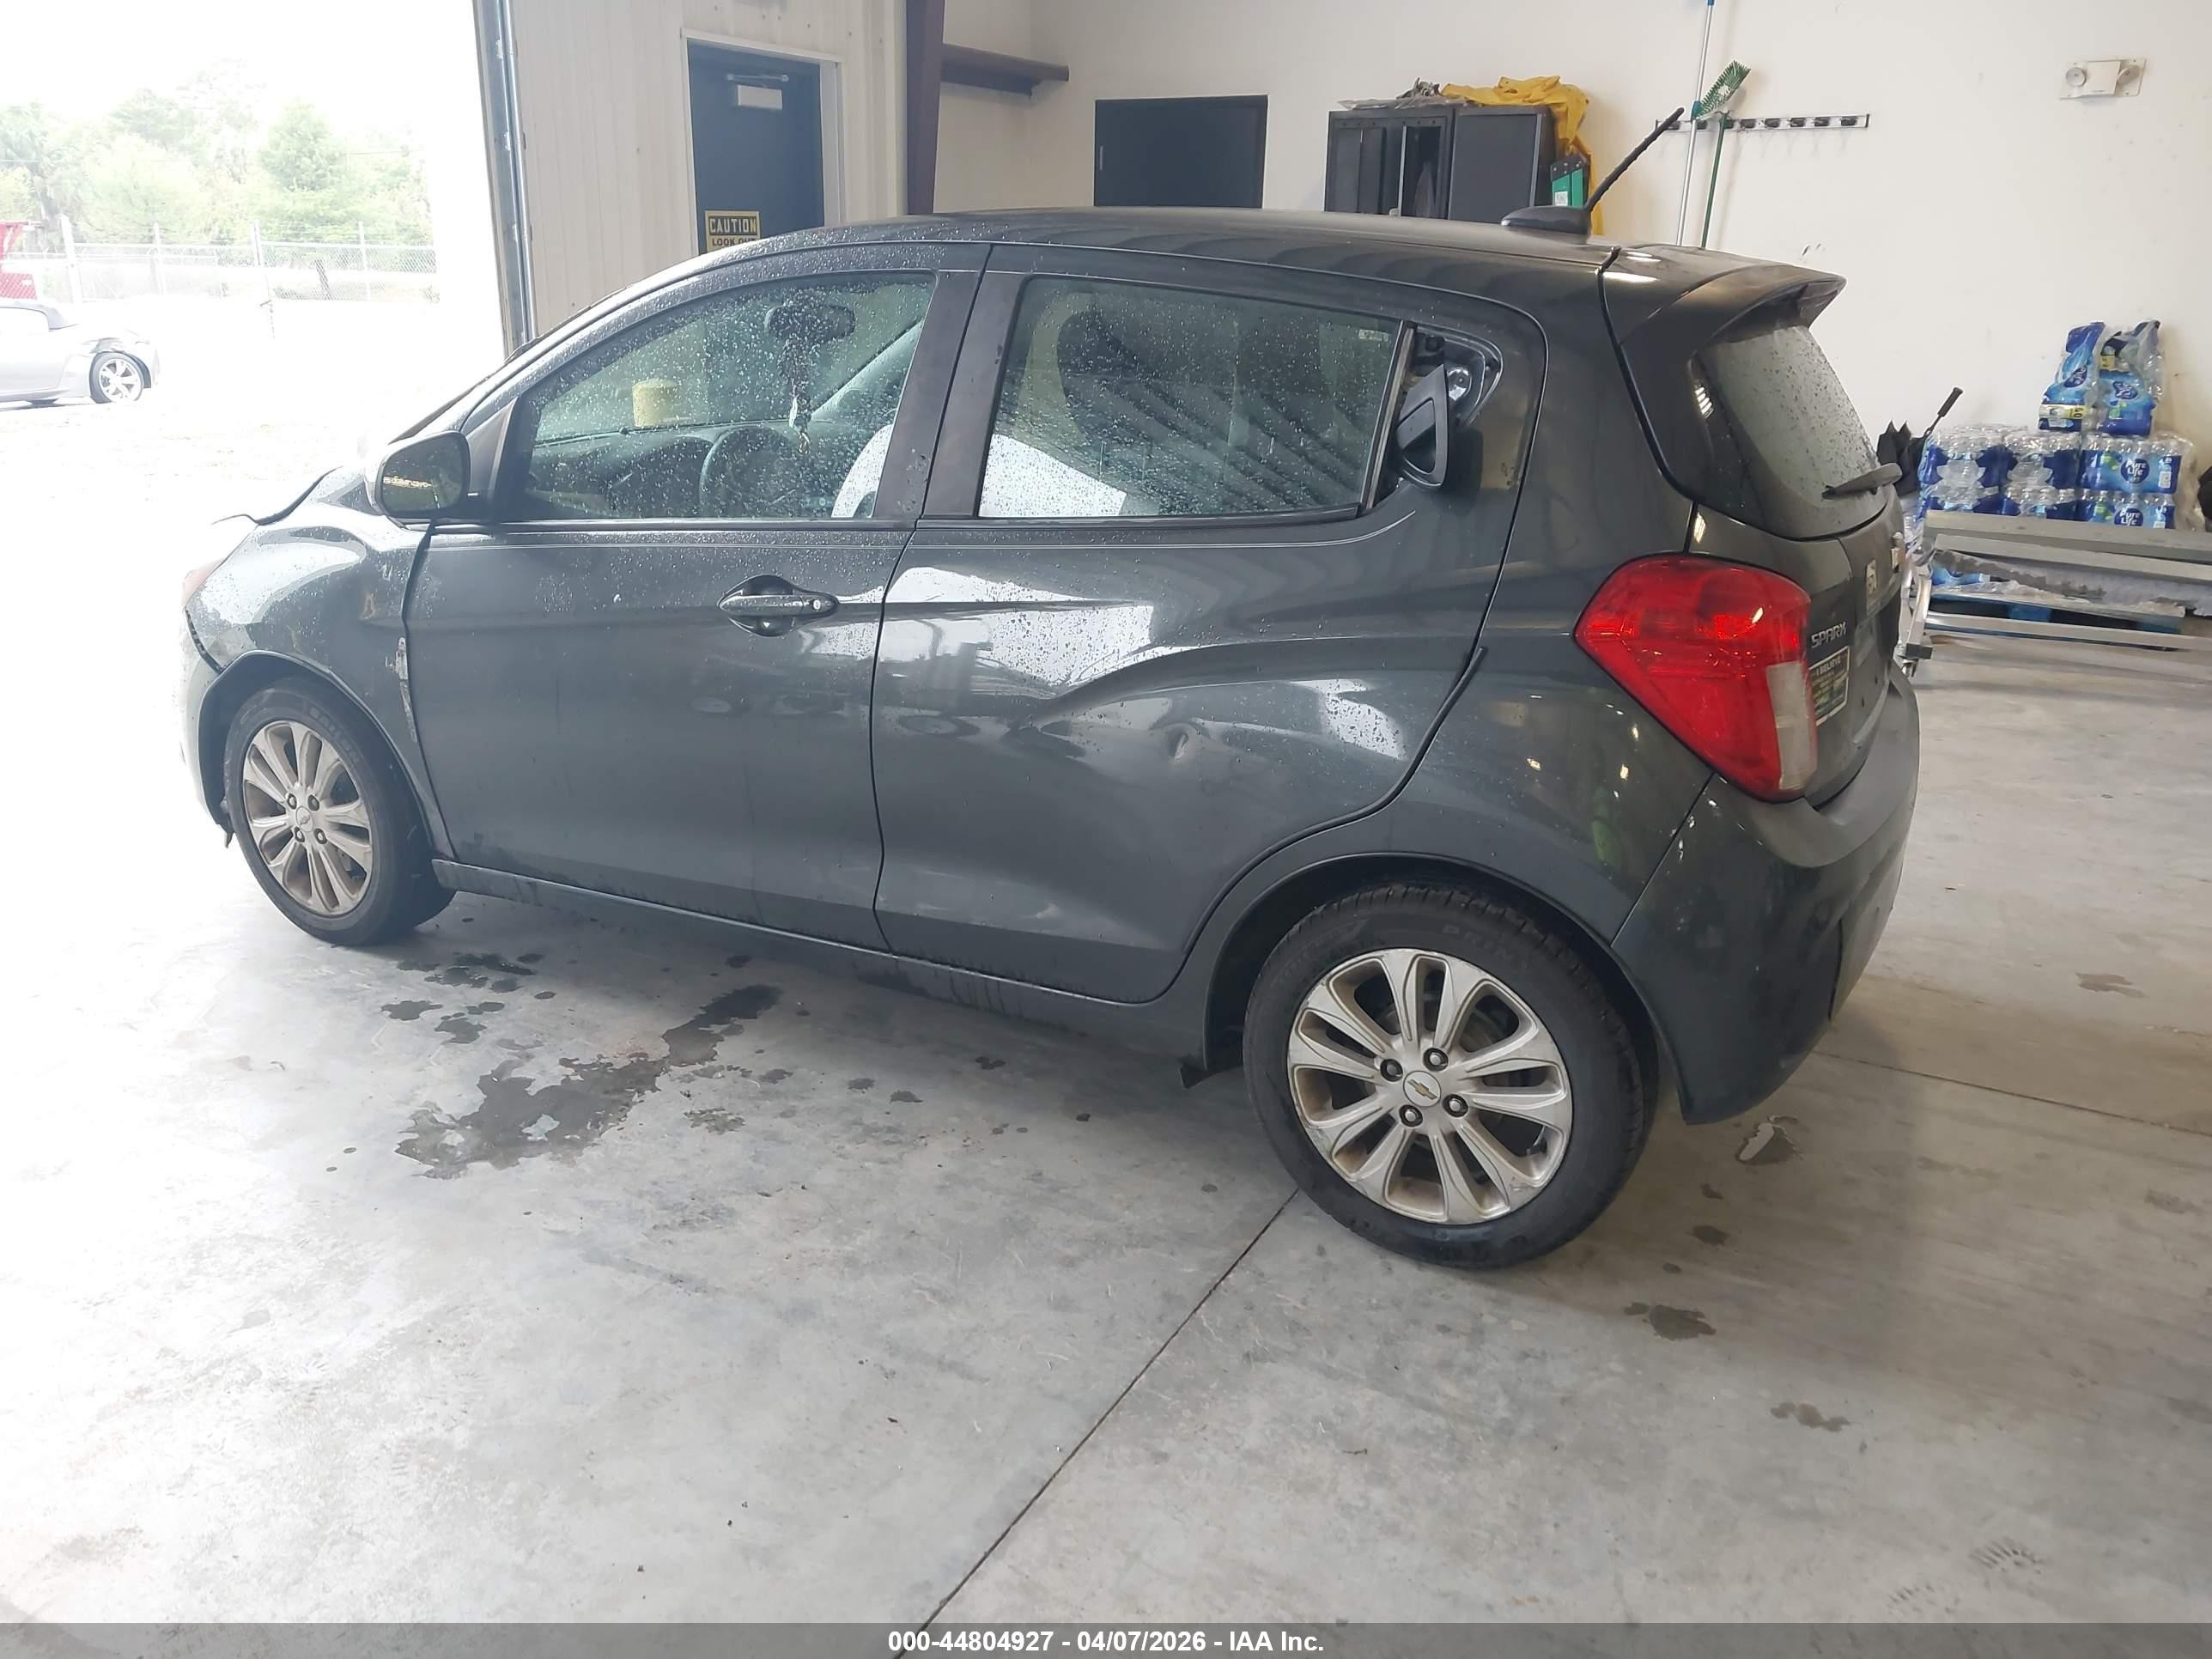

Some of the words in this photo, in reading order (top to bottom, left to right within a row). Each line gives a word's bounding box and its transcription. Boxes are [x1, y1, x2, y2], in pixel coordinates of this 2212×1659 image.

[709, 218, 757, 233] CAUTION
[712, 238, 736, 246] LOOK
[2124, 458, 2147, 470] Pure
[1811, 621, 1847, 648] SPARK
